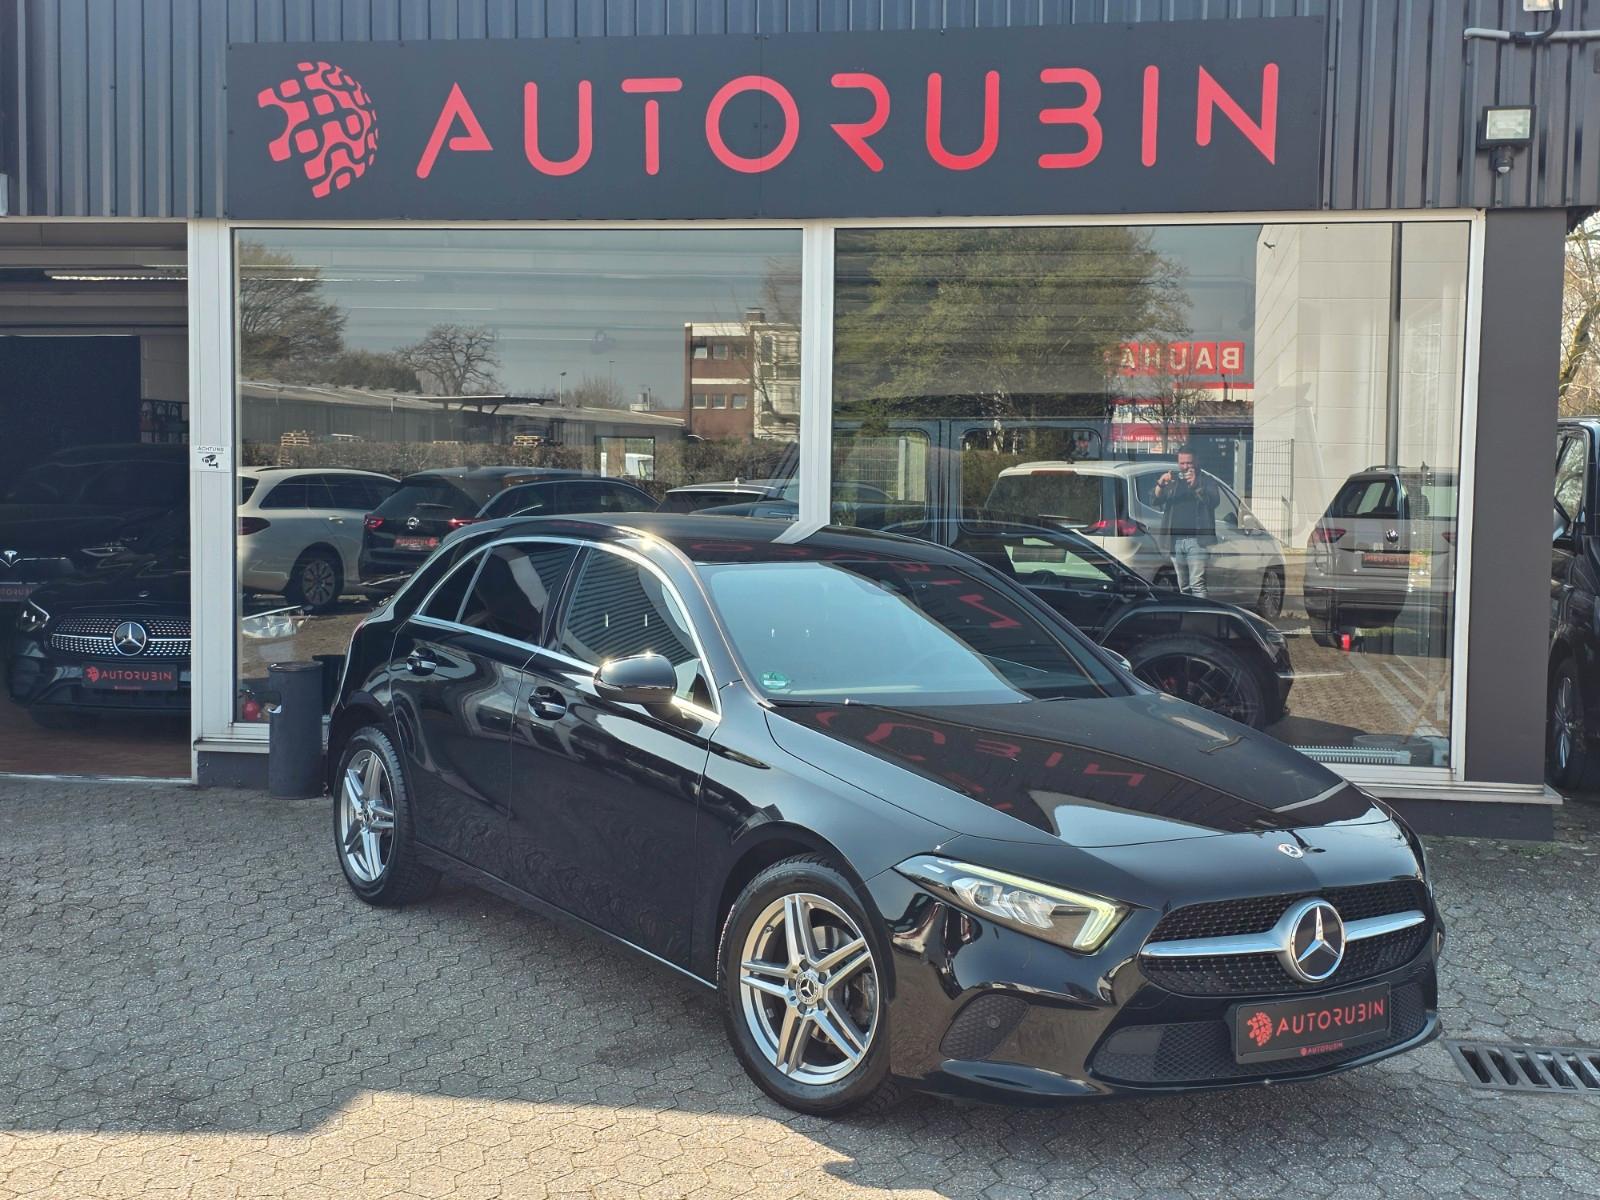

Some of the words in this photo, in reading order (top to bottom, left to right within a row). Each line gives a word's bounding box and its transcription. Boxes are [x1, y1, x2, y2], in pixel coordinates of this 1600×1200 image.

[416, 62, 1279, 179] AUTORUBIN
[101, 671, 171, 680] AUTORUBIN
[1276, 999, 1384, 1037] AUTORUBIN
